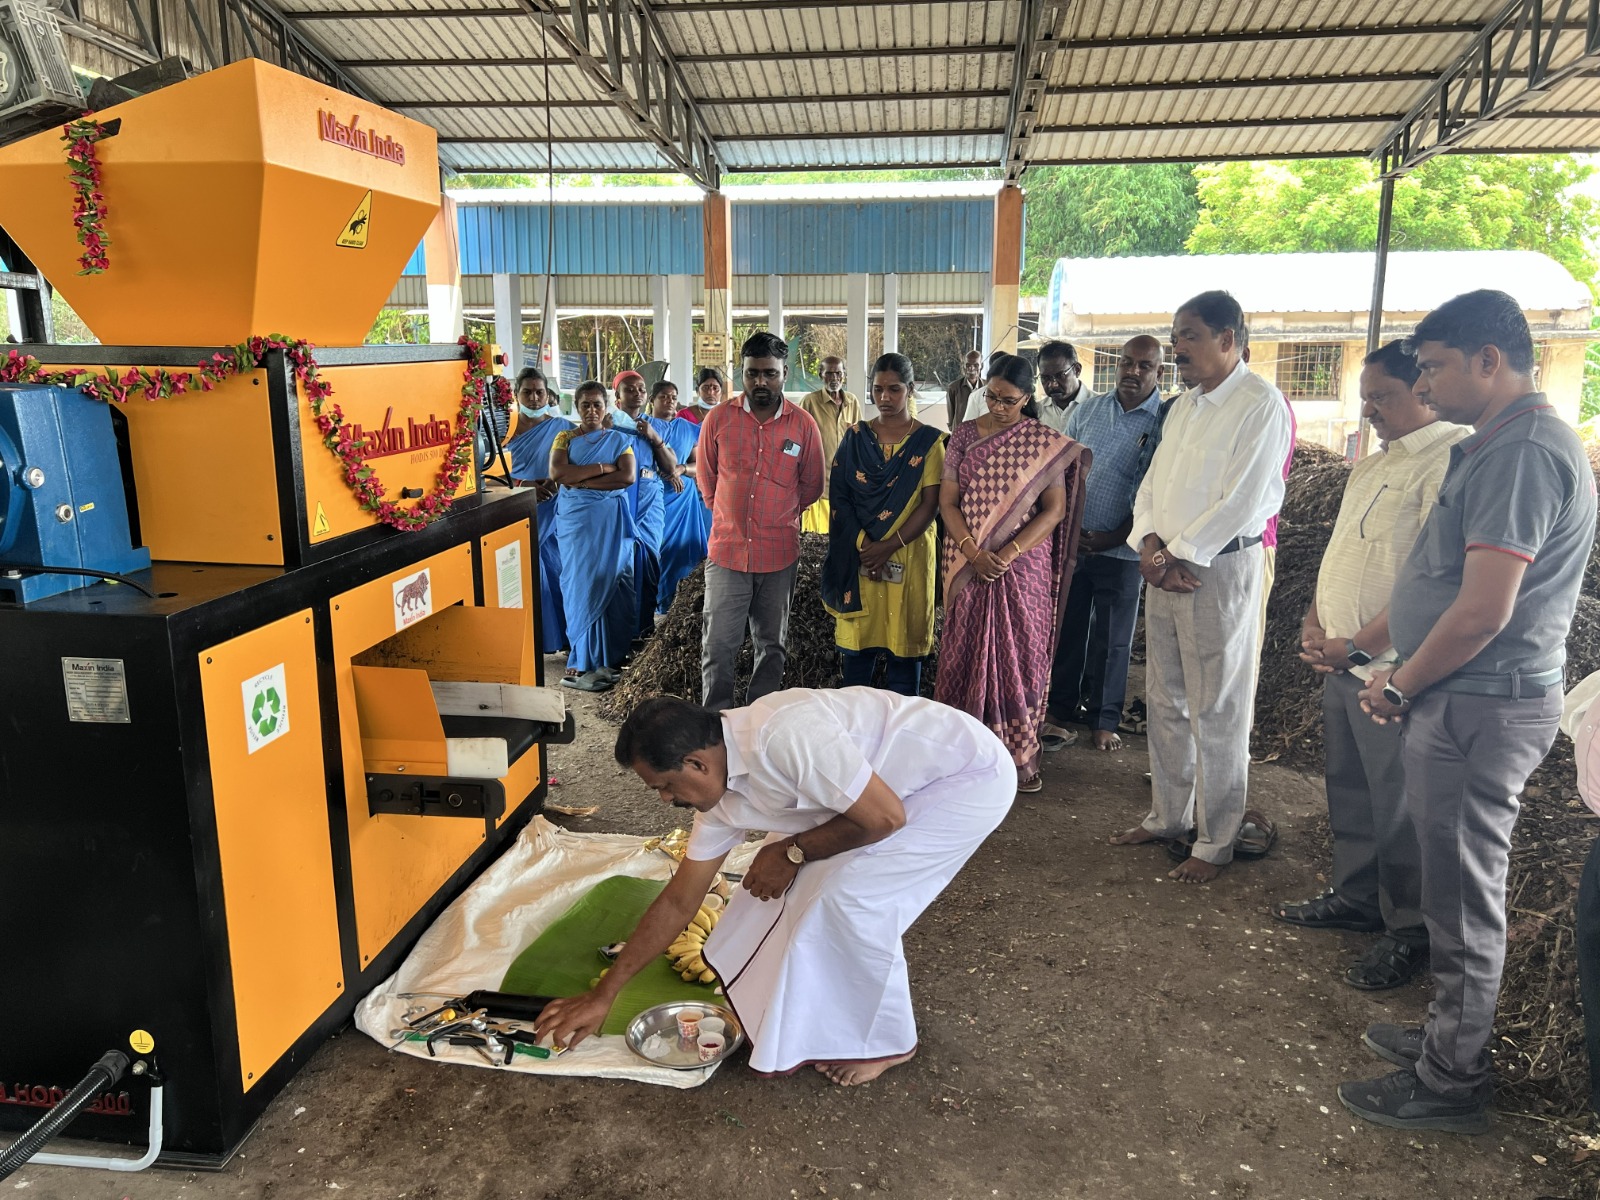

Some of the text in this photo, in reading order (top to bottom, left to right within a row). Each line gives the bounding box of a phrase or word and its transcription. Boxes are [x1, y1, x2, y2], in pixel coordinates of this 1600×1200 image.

[317, 107, 406, 165] Maxin India
[408, 414, 451, 449] India
[71, 662, 95, 671] Maxin
